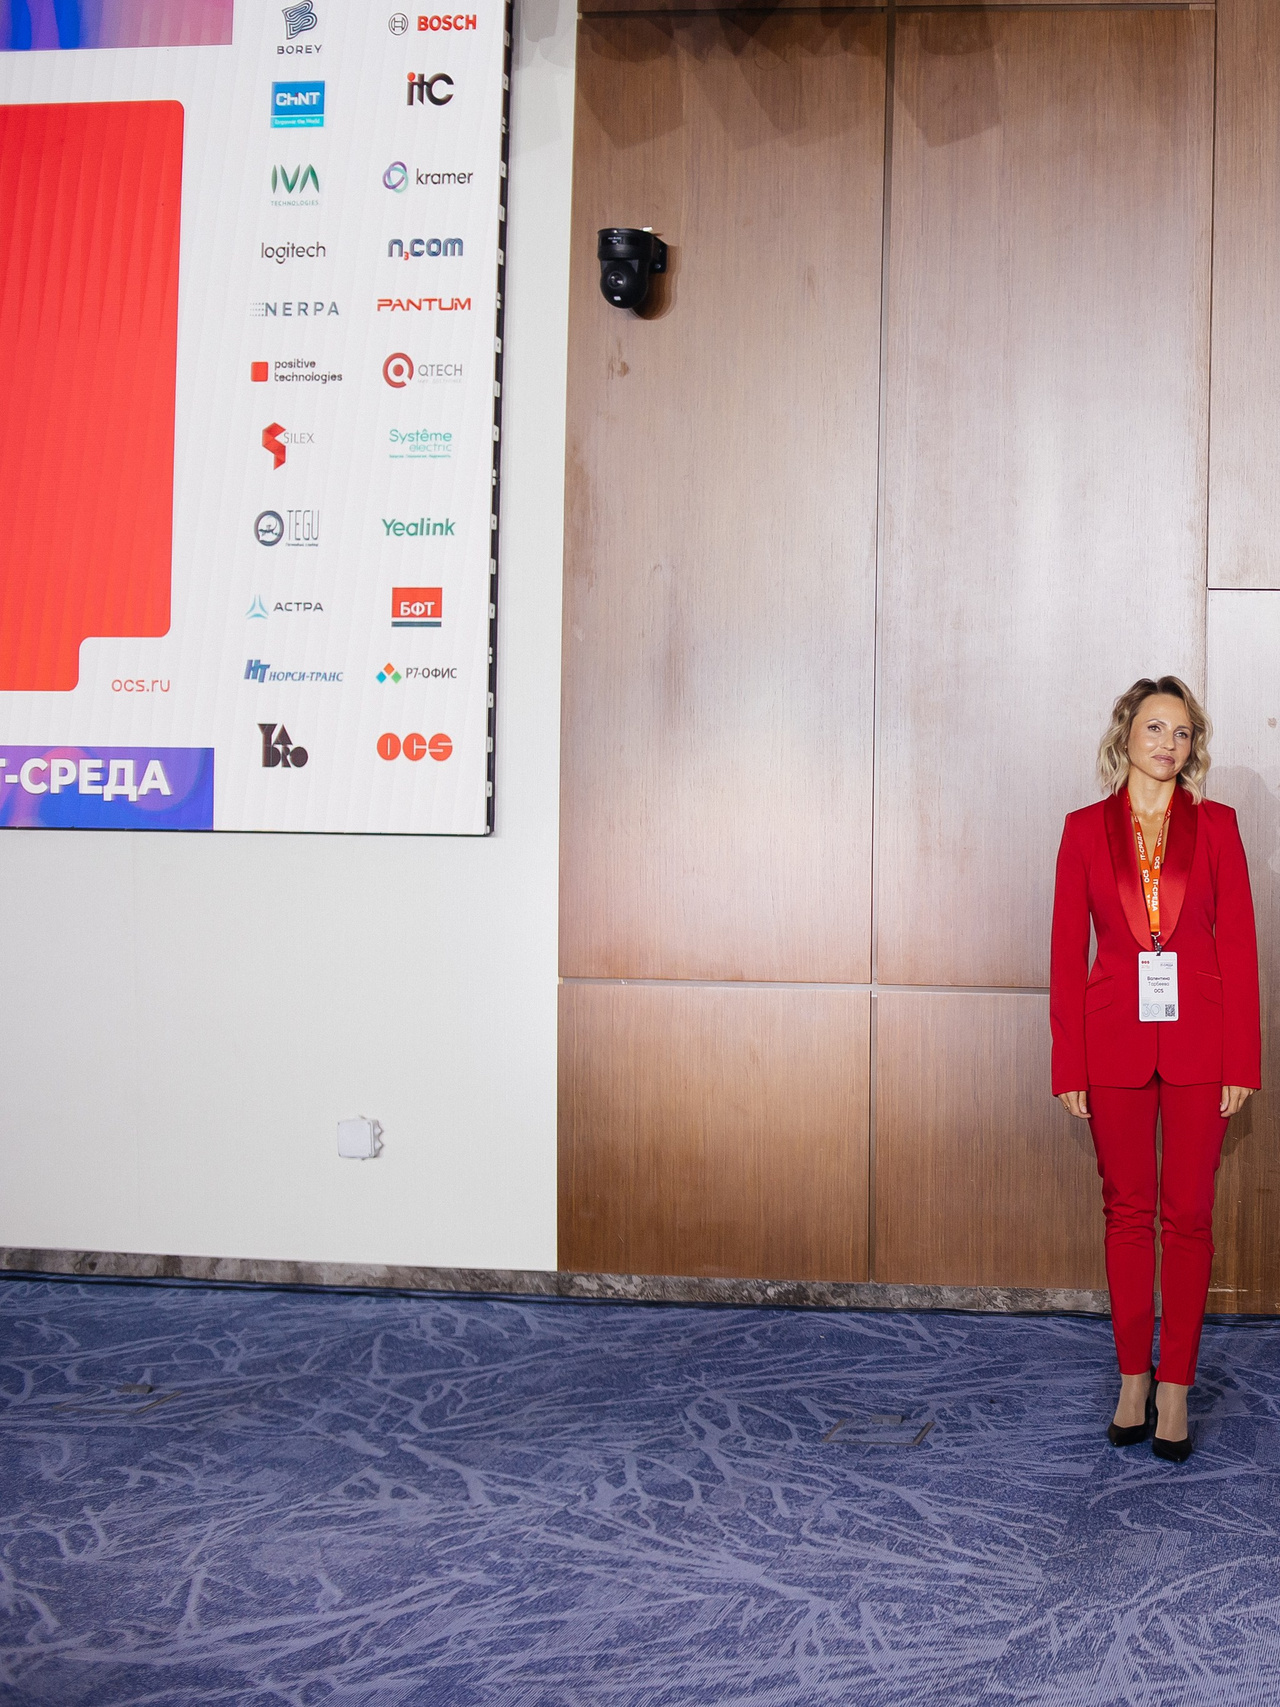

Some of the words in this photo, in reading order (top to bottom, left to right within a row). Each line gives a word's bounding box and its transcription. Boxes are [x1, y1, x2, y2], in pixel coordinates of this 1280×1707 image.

[417, 14, 477, 31] BOSCH
[277, 44, 322, 55] BOREY
[271, 163, 320, 194] IVA
[415, 168, 473, 185] kramer
[261, 241, 326, 264] logitech
[264, 301, 340, 317] NERPA
[377, 297, 471, 311] PANTUM
[274, 358, 316, 370] positive
[417, 363, 463, 377] QTECH
[274, 371, 343, 384] technologies
[283, 432, 315, 444] SILEX
[409, 442, 452, 453] electric
[286, 509, 320, 541] TEGU
[381, 518, 456, 537] Yealink
[273, 602, 324, 612] АСТРА
[400, 601, 435, 616] БФТ
[268, 671, 344, 682] НОРСИ-ТРАНС
[405, 667, 458, 680] Р7-ОФИС
[111, 679, 171, 692] ocs.ru
[376, 732, 453, 761] OCS
[0, 757, 173, 802] -СРЕДА
[1142, 869, 1150, 883] OCS
